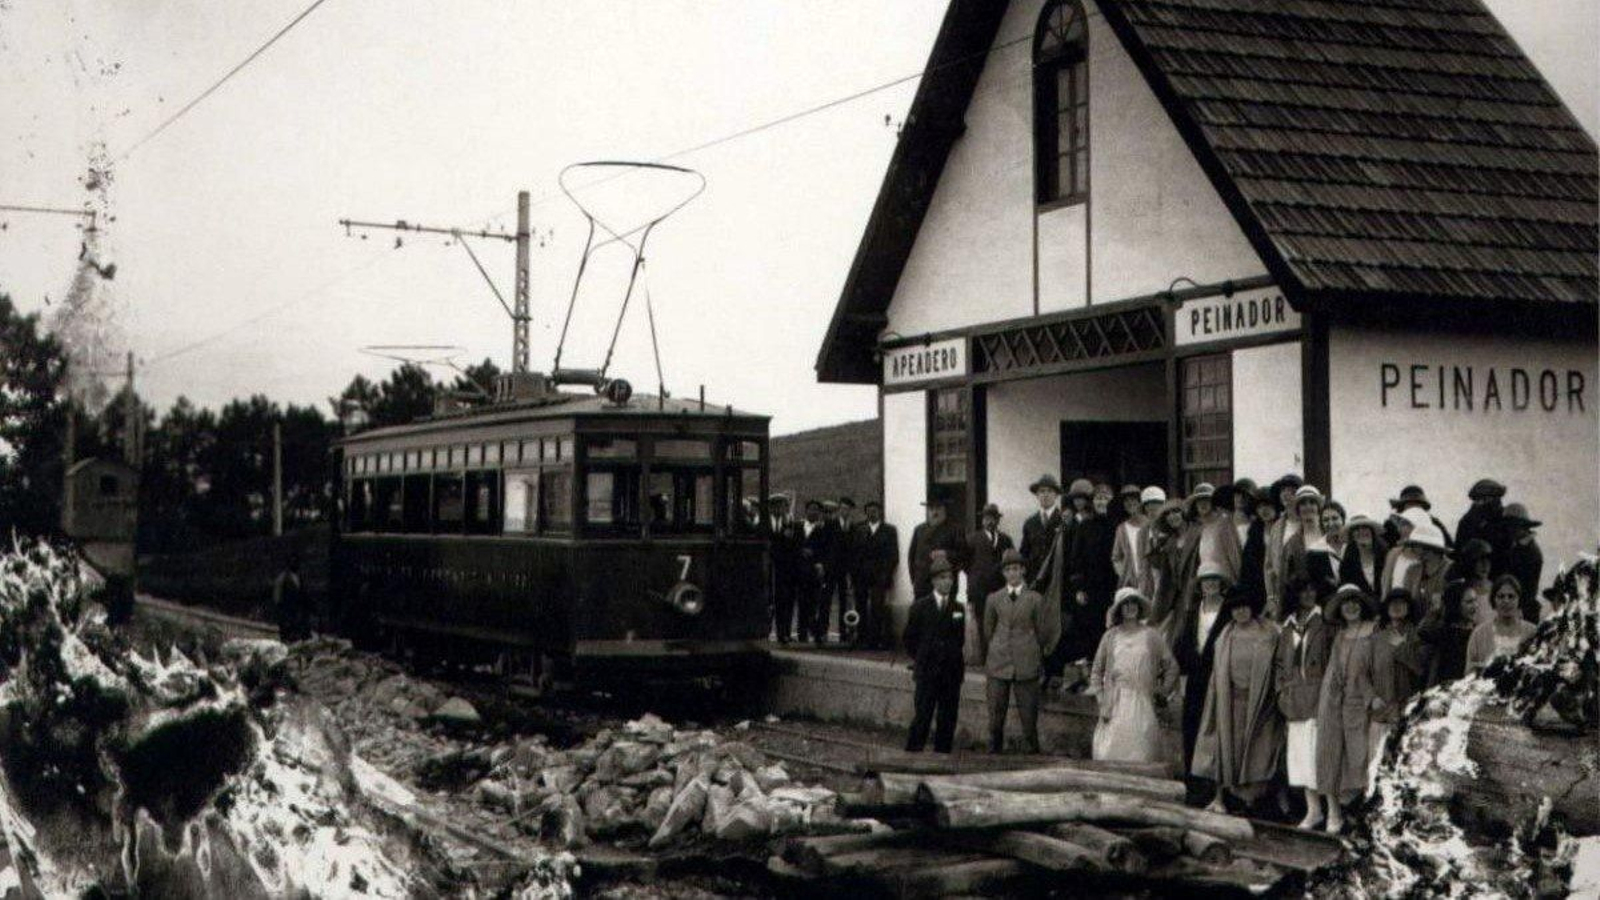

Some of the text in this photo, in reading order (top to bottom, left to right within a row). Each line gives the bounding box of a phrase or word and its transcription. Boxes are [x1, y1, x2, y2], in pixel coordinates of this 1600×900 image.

[1191, 296, 1285, 336] PEINADOR
[893, 347, 957, 377] APEADERO
[1381, 363, 1585, 413] PEINADOR
[677, 554, 692, 580] 7
